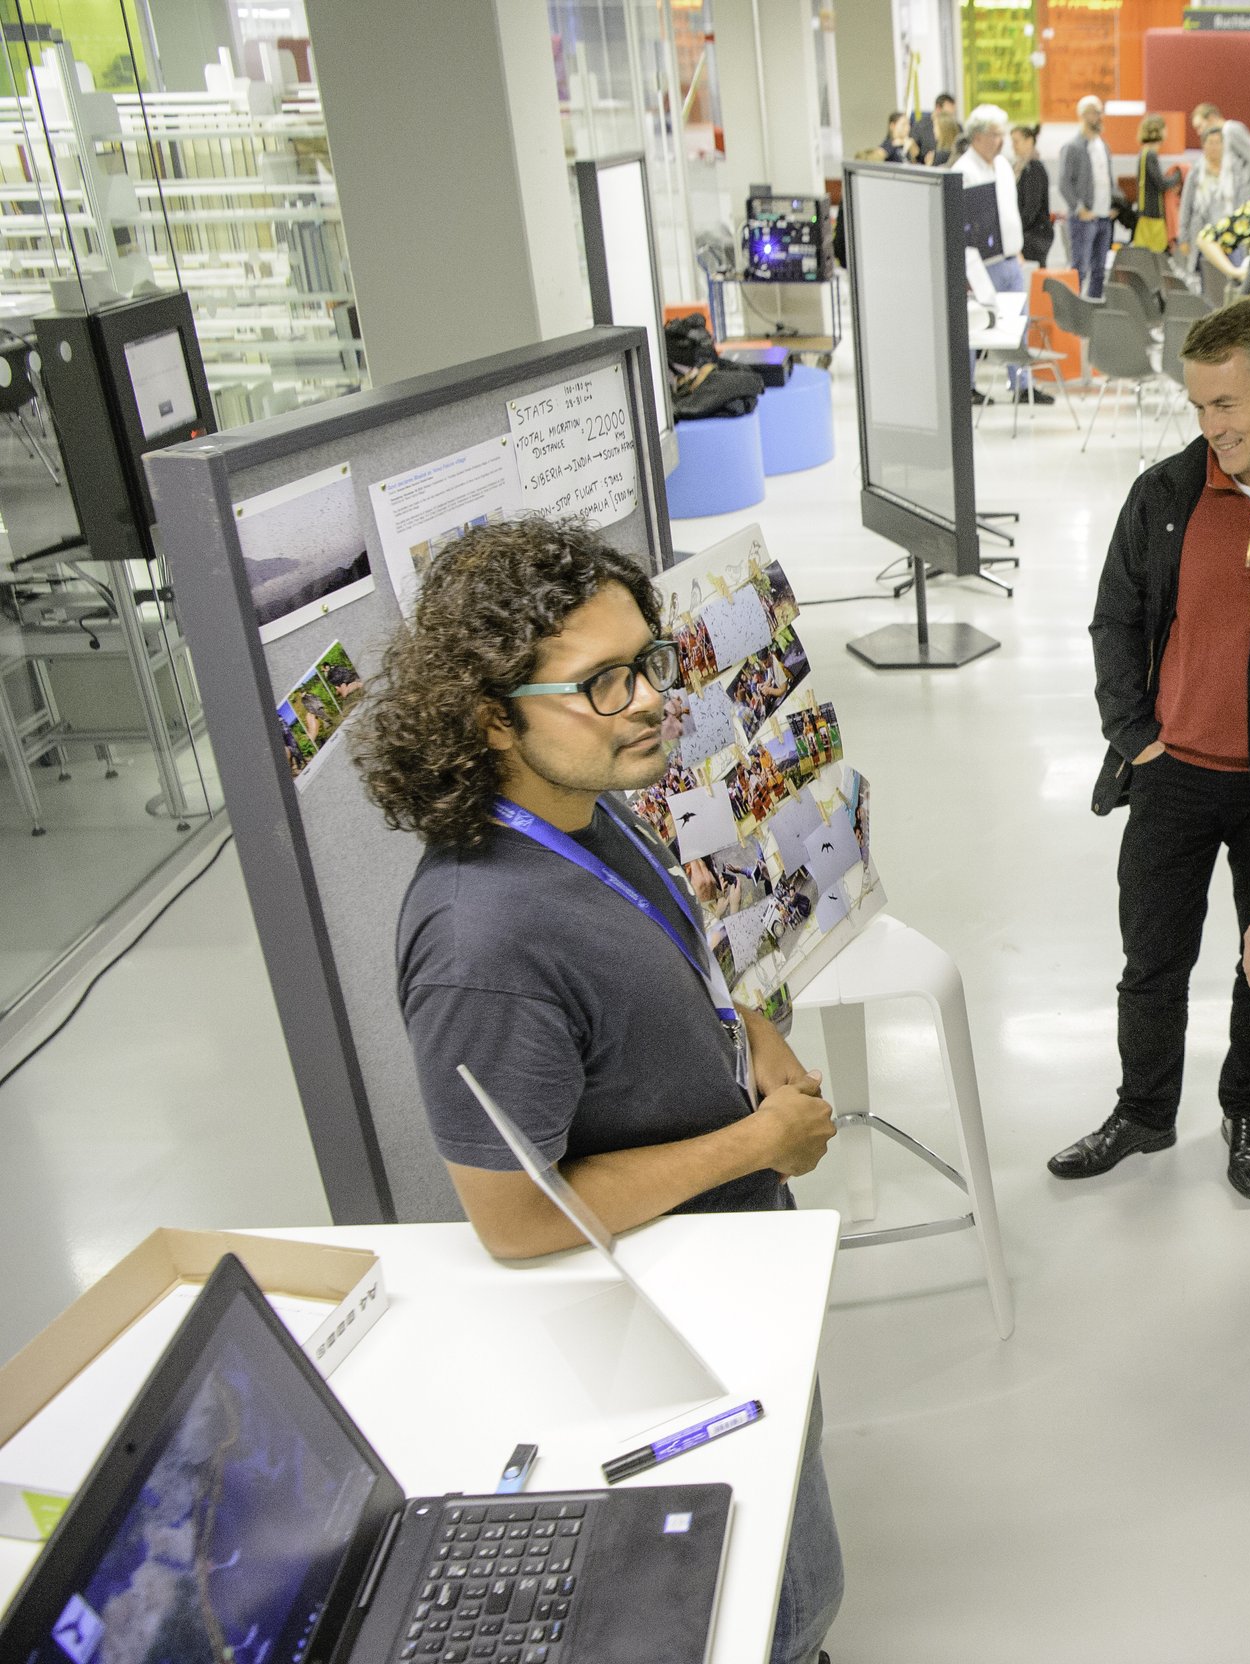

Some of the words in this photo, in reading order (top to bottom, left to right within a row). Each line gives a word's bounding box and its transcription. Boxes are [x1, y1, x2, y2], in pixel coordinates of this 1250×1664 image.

[518, 431, 545, 449] TOTAL
[548, 418, 580, 437] MIGRATION
[532, 439, 565, 459] DISTANCE
[531, 465, 562, 490] SIBERIA
[571, 455, 593, 473] INDIA
[602, 446, 620, 461] SOUTH
[580, 498, 610, 520] SOMALIA
